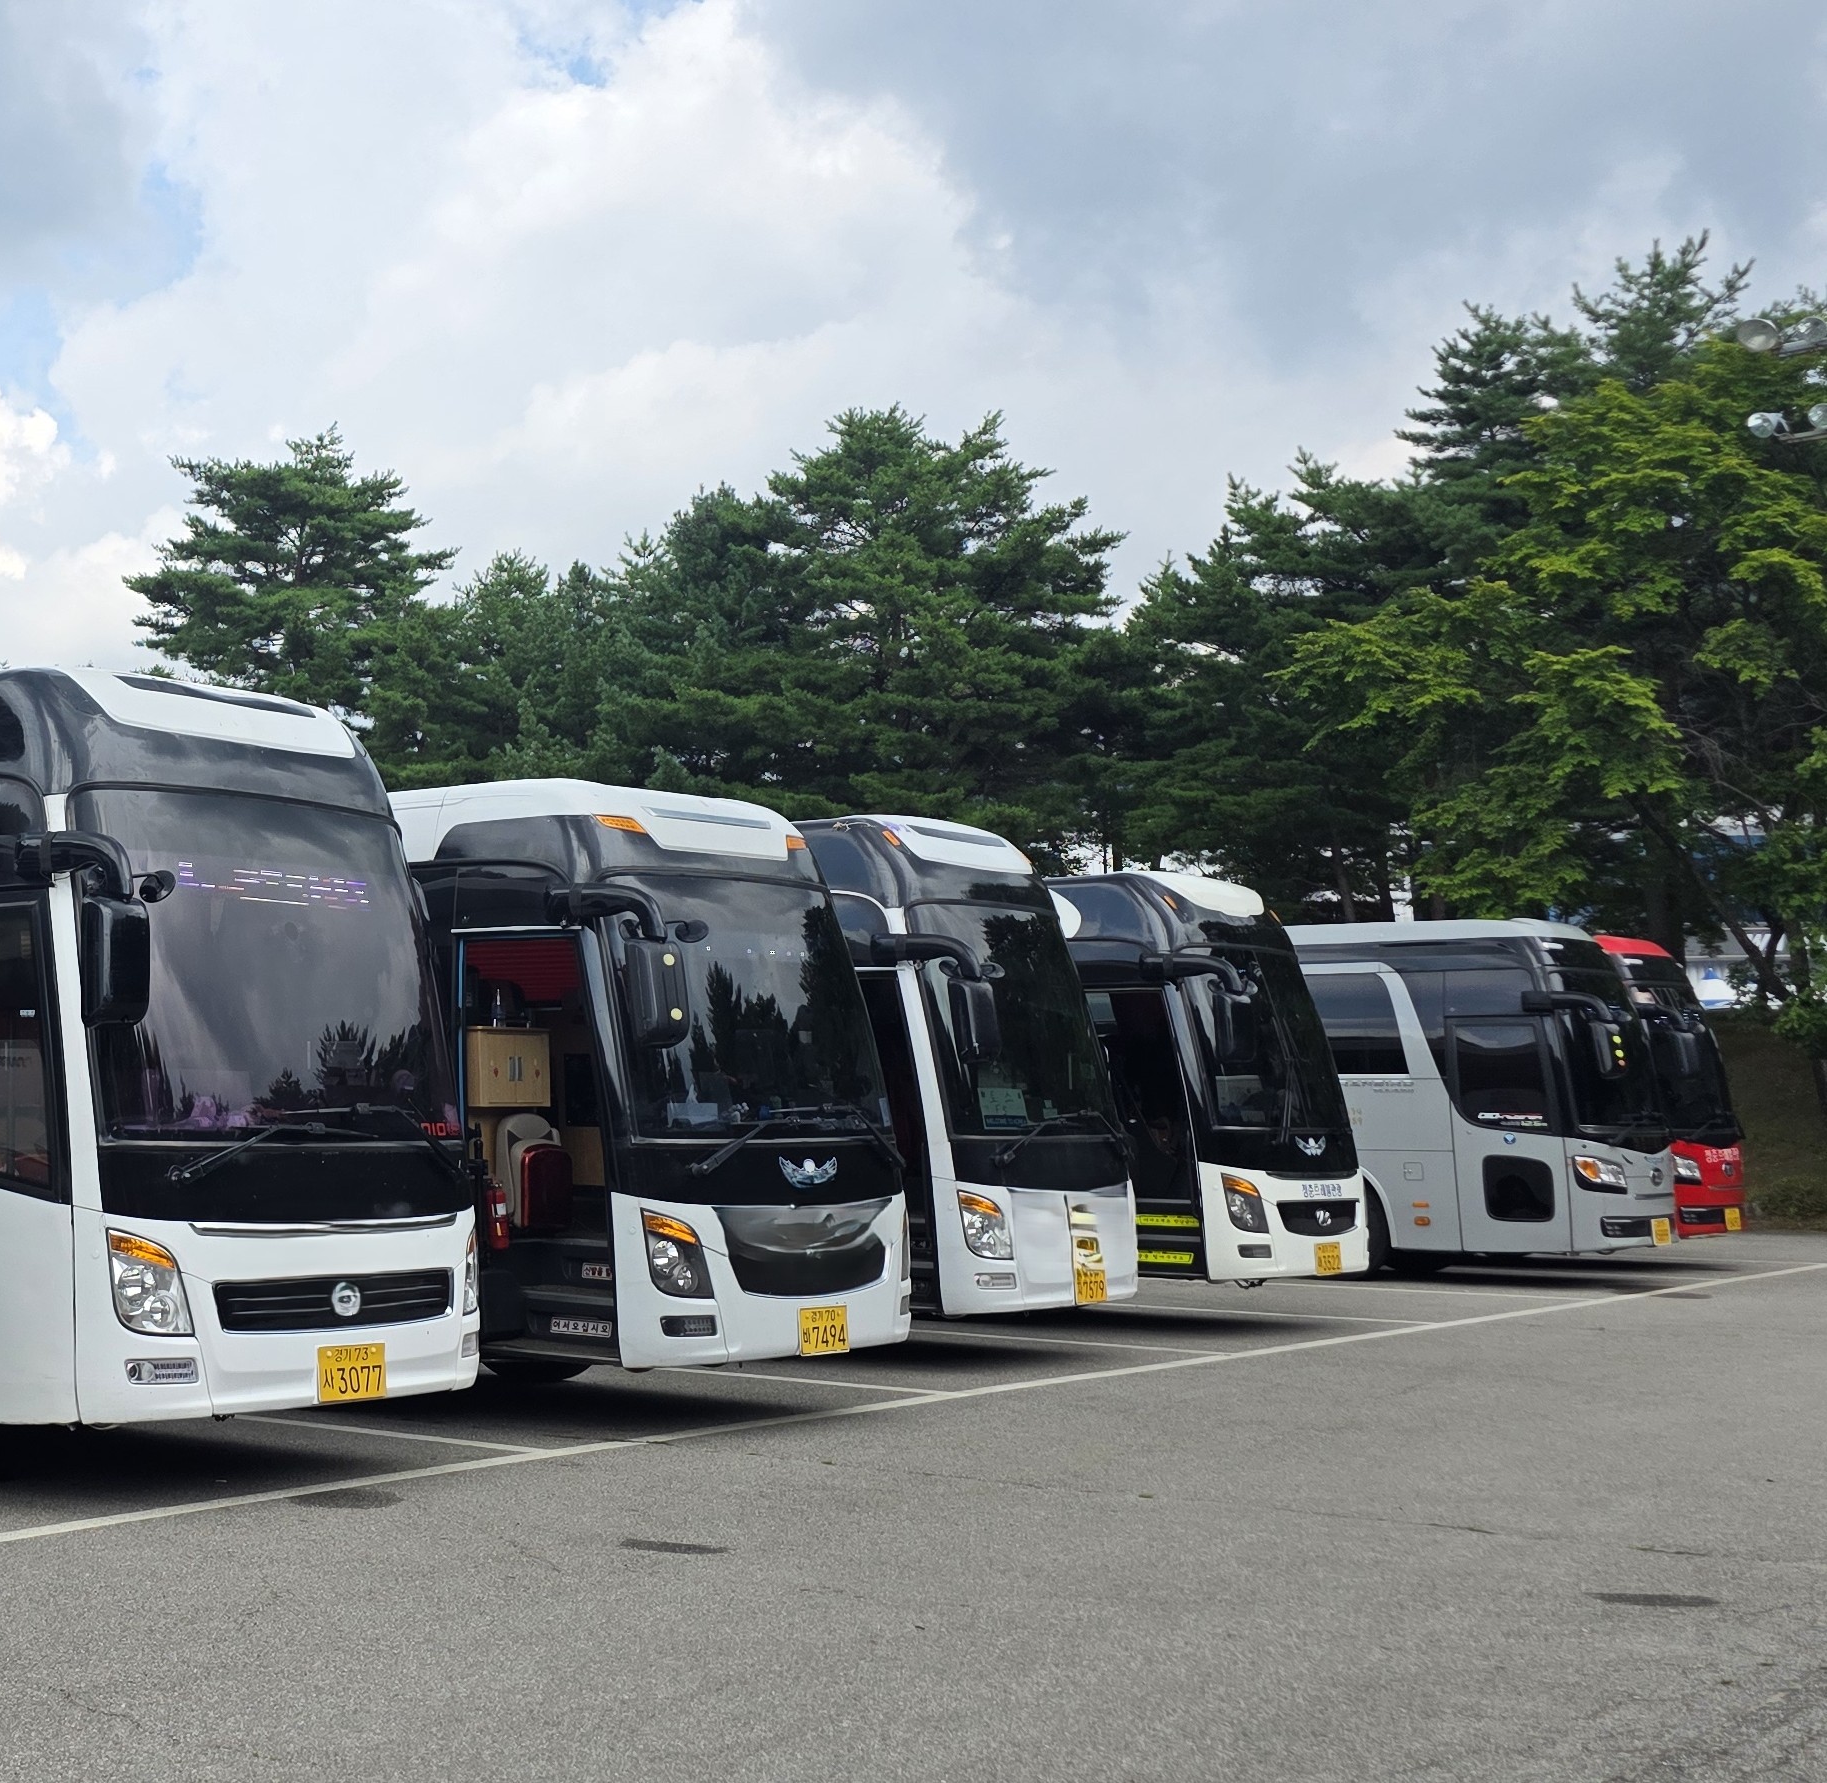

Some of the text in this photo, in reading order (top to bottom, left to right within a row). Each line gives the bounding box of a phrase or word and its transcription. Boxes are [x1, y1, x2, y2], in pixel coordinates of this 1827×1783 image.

[552, 1320, 608, 1333] 어서오십시오
[812, 1323, 846, 1349] 7494
[334, 1347, 369, 1363] 경기 73
[323, 1364, 382, 1394] 사 3077
